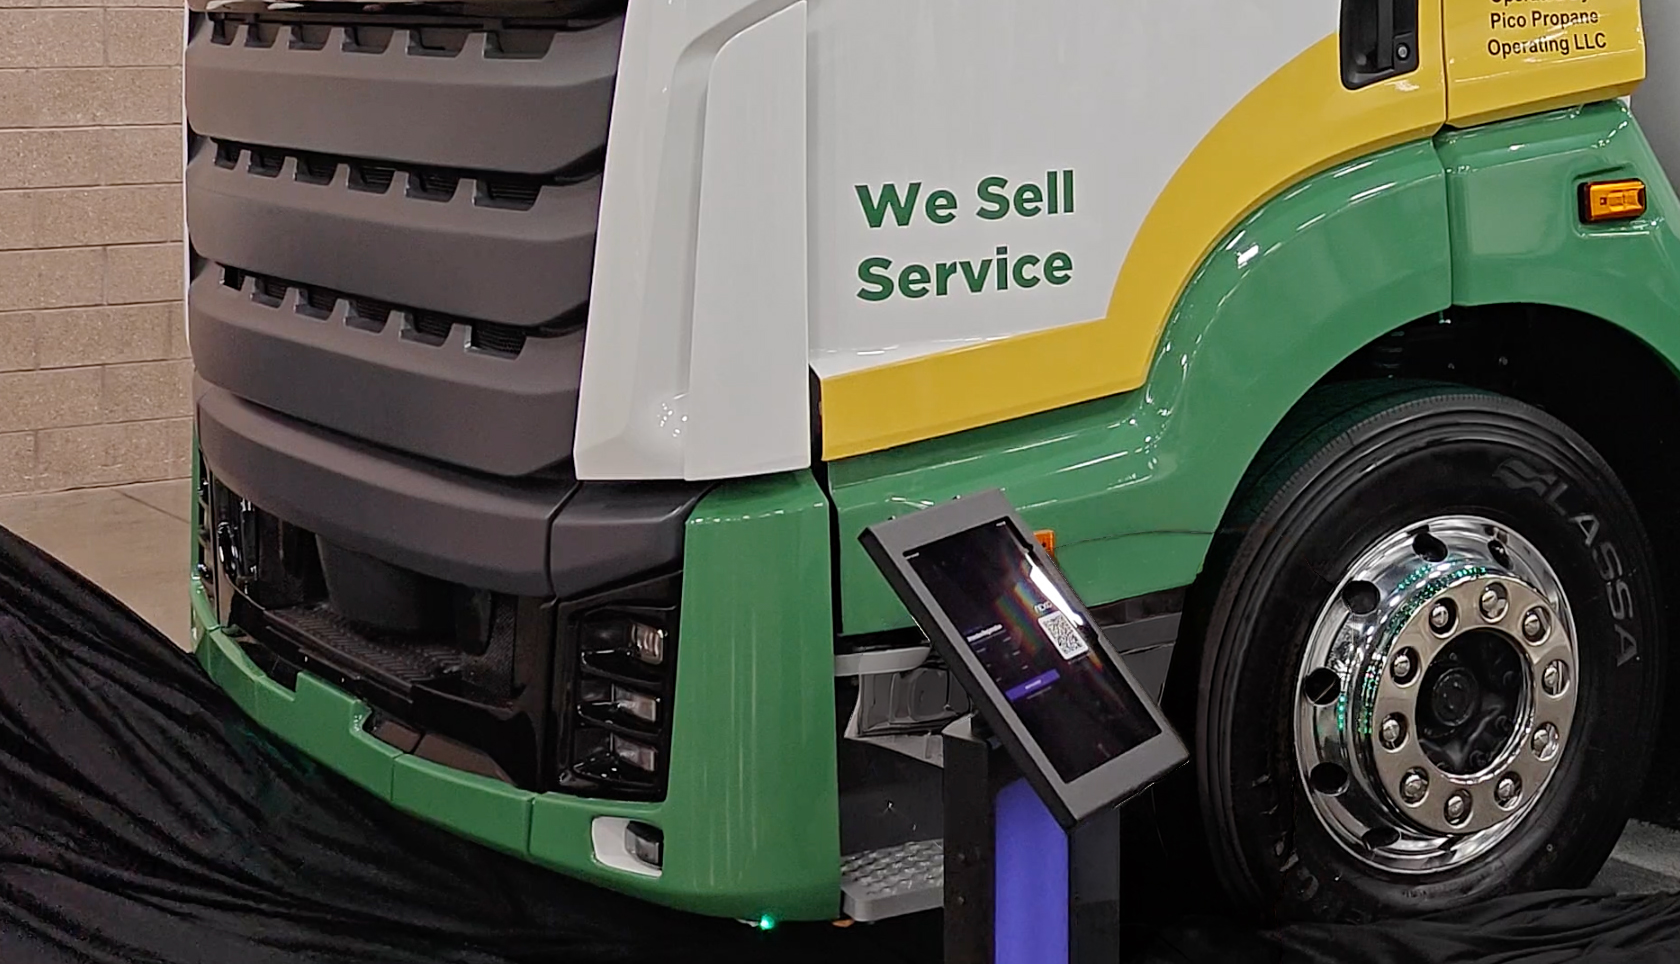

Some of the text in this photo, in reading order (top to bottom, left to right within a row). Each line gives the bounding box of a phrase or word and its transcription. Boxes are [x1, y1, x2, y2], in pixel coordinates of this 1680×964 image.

[1487, 32, 1607, 59] Operating LLC
[1490, 10, 1599, 30] Pico Propane
[854, 169, 1074, 229] We Sell
[856, 245, 1073, 302] Service
[1542, 482, 1638, 667] LASSA
